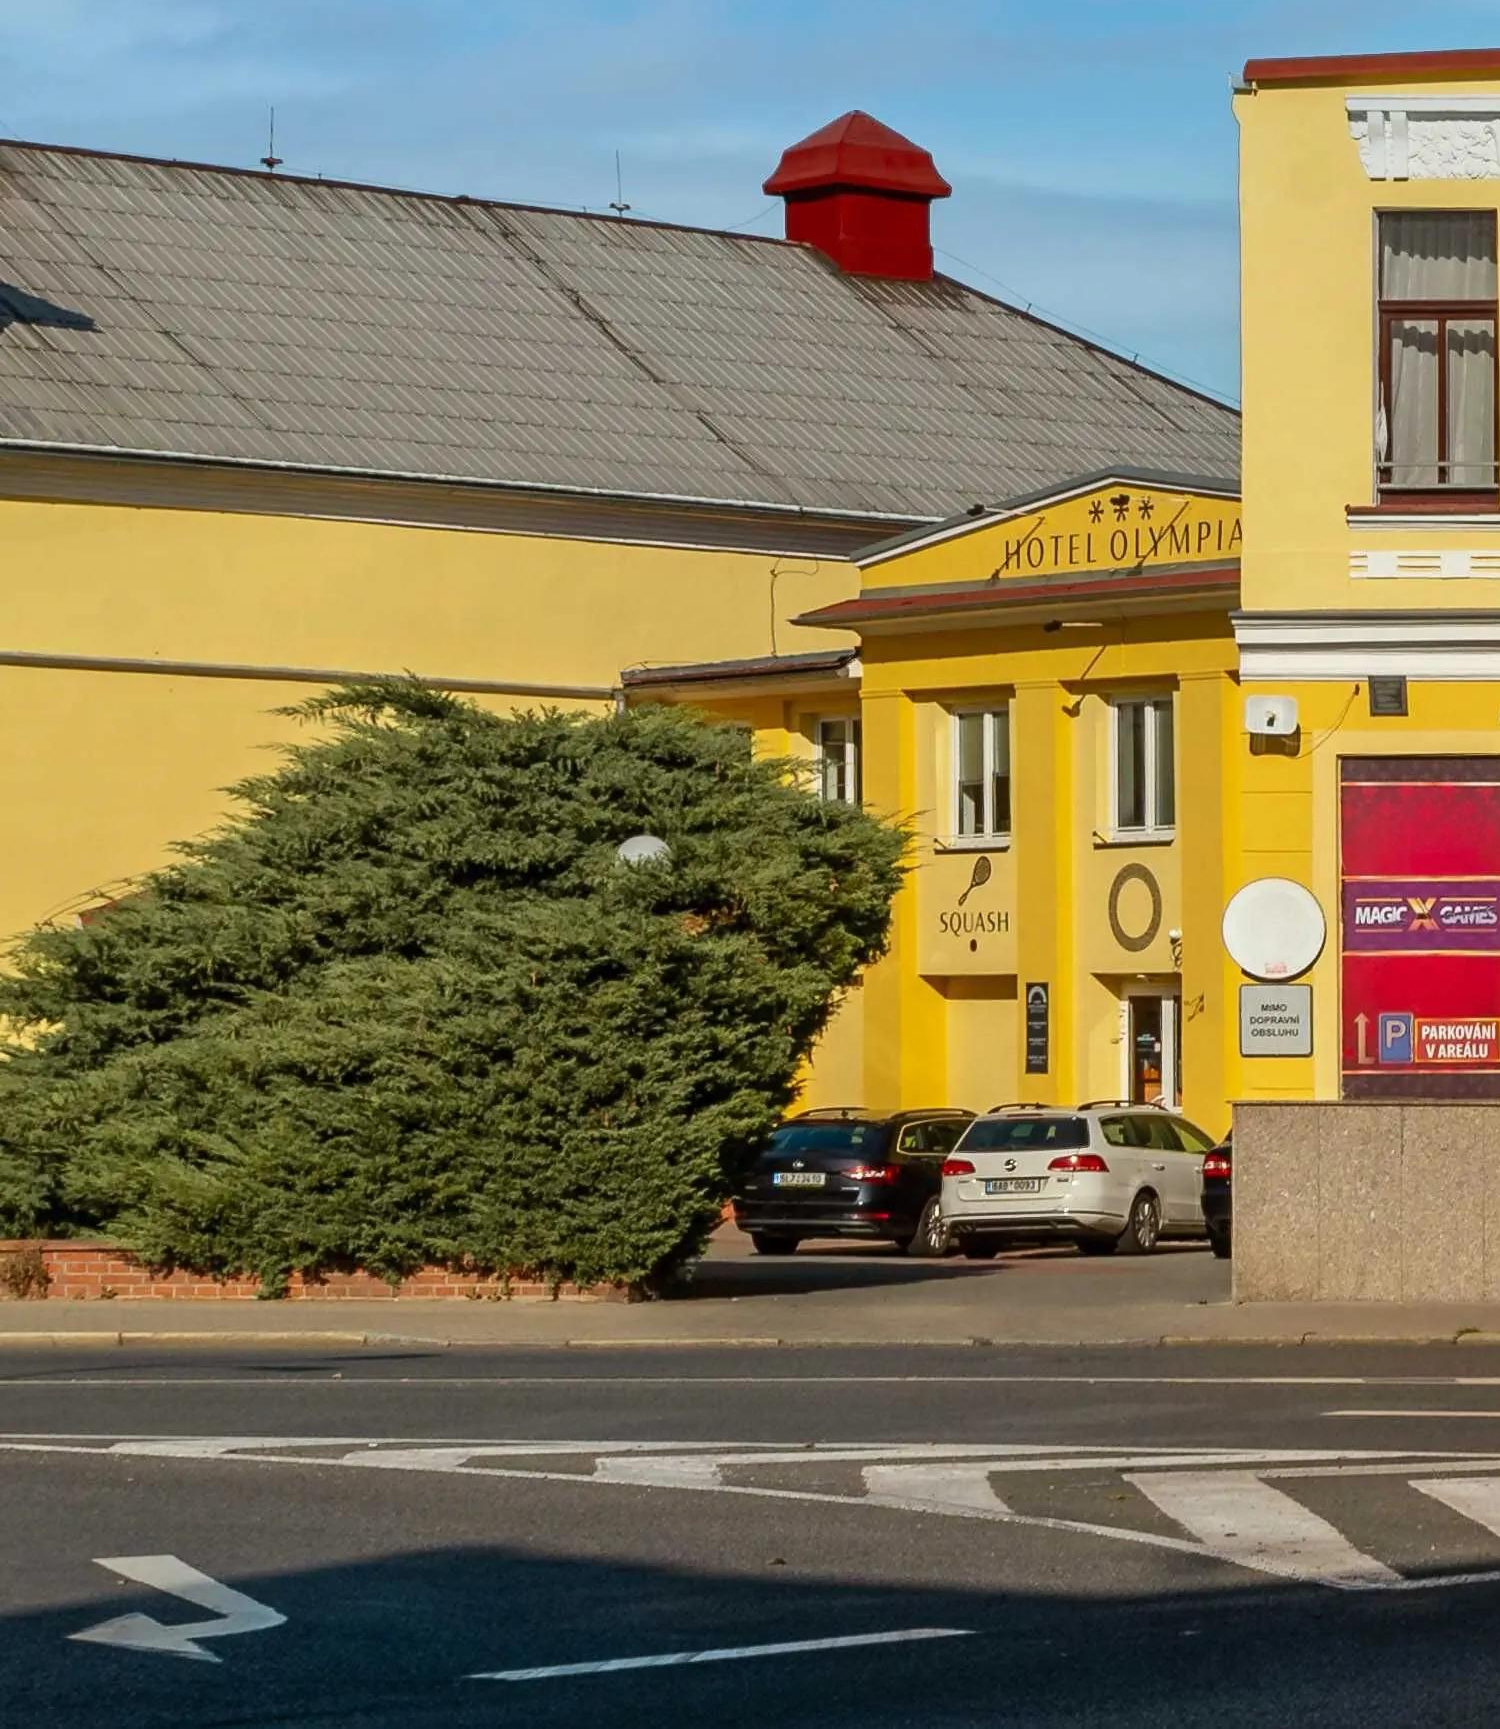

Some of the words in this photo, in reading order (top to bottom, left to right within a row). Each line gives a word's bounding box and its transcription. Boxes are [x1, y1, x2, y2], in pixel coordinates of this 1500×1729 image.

[1005, 532, 1096, 569] HOTEL
[1110, 518, 1242, 561] OLYMPIA
[940, 911, 1009, 937] SQUASH
[1355, 906, 1407, 925] MAGIC
[1440, 905, 1498, 925] GAMES
[1260, 1003, 1288, 1012] MIMO
[1249, 1014, 1300, 1024] DOPRAVNÍ
[1251, 1028, 1299, 1037] OBSLUHU
[1385, 1020, 1406, 1048] P
[1421, 1022, 1496, 1040] PARKOVÁNÍ
[1426, 1044, 1436, 1058] V
[1438, 1041, 1489, 1058] AREÁLU
